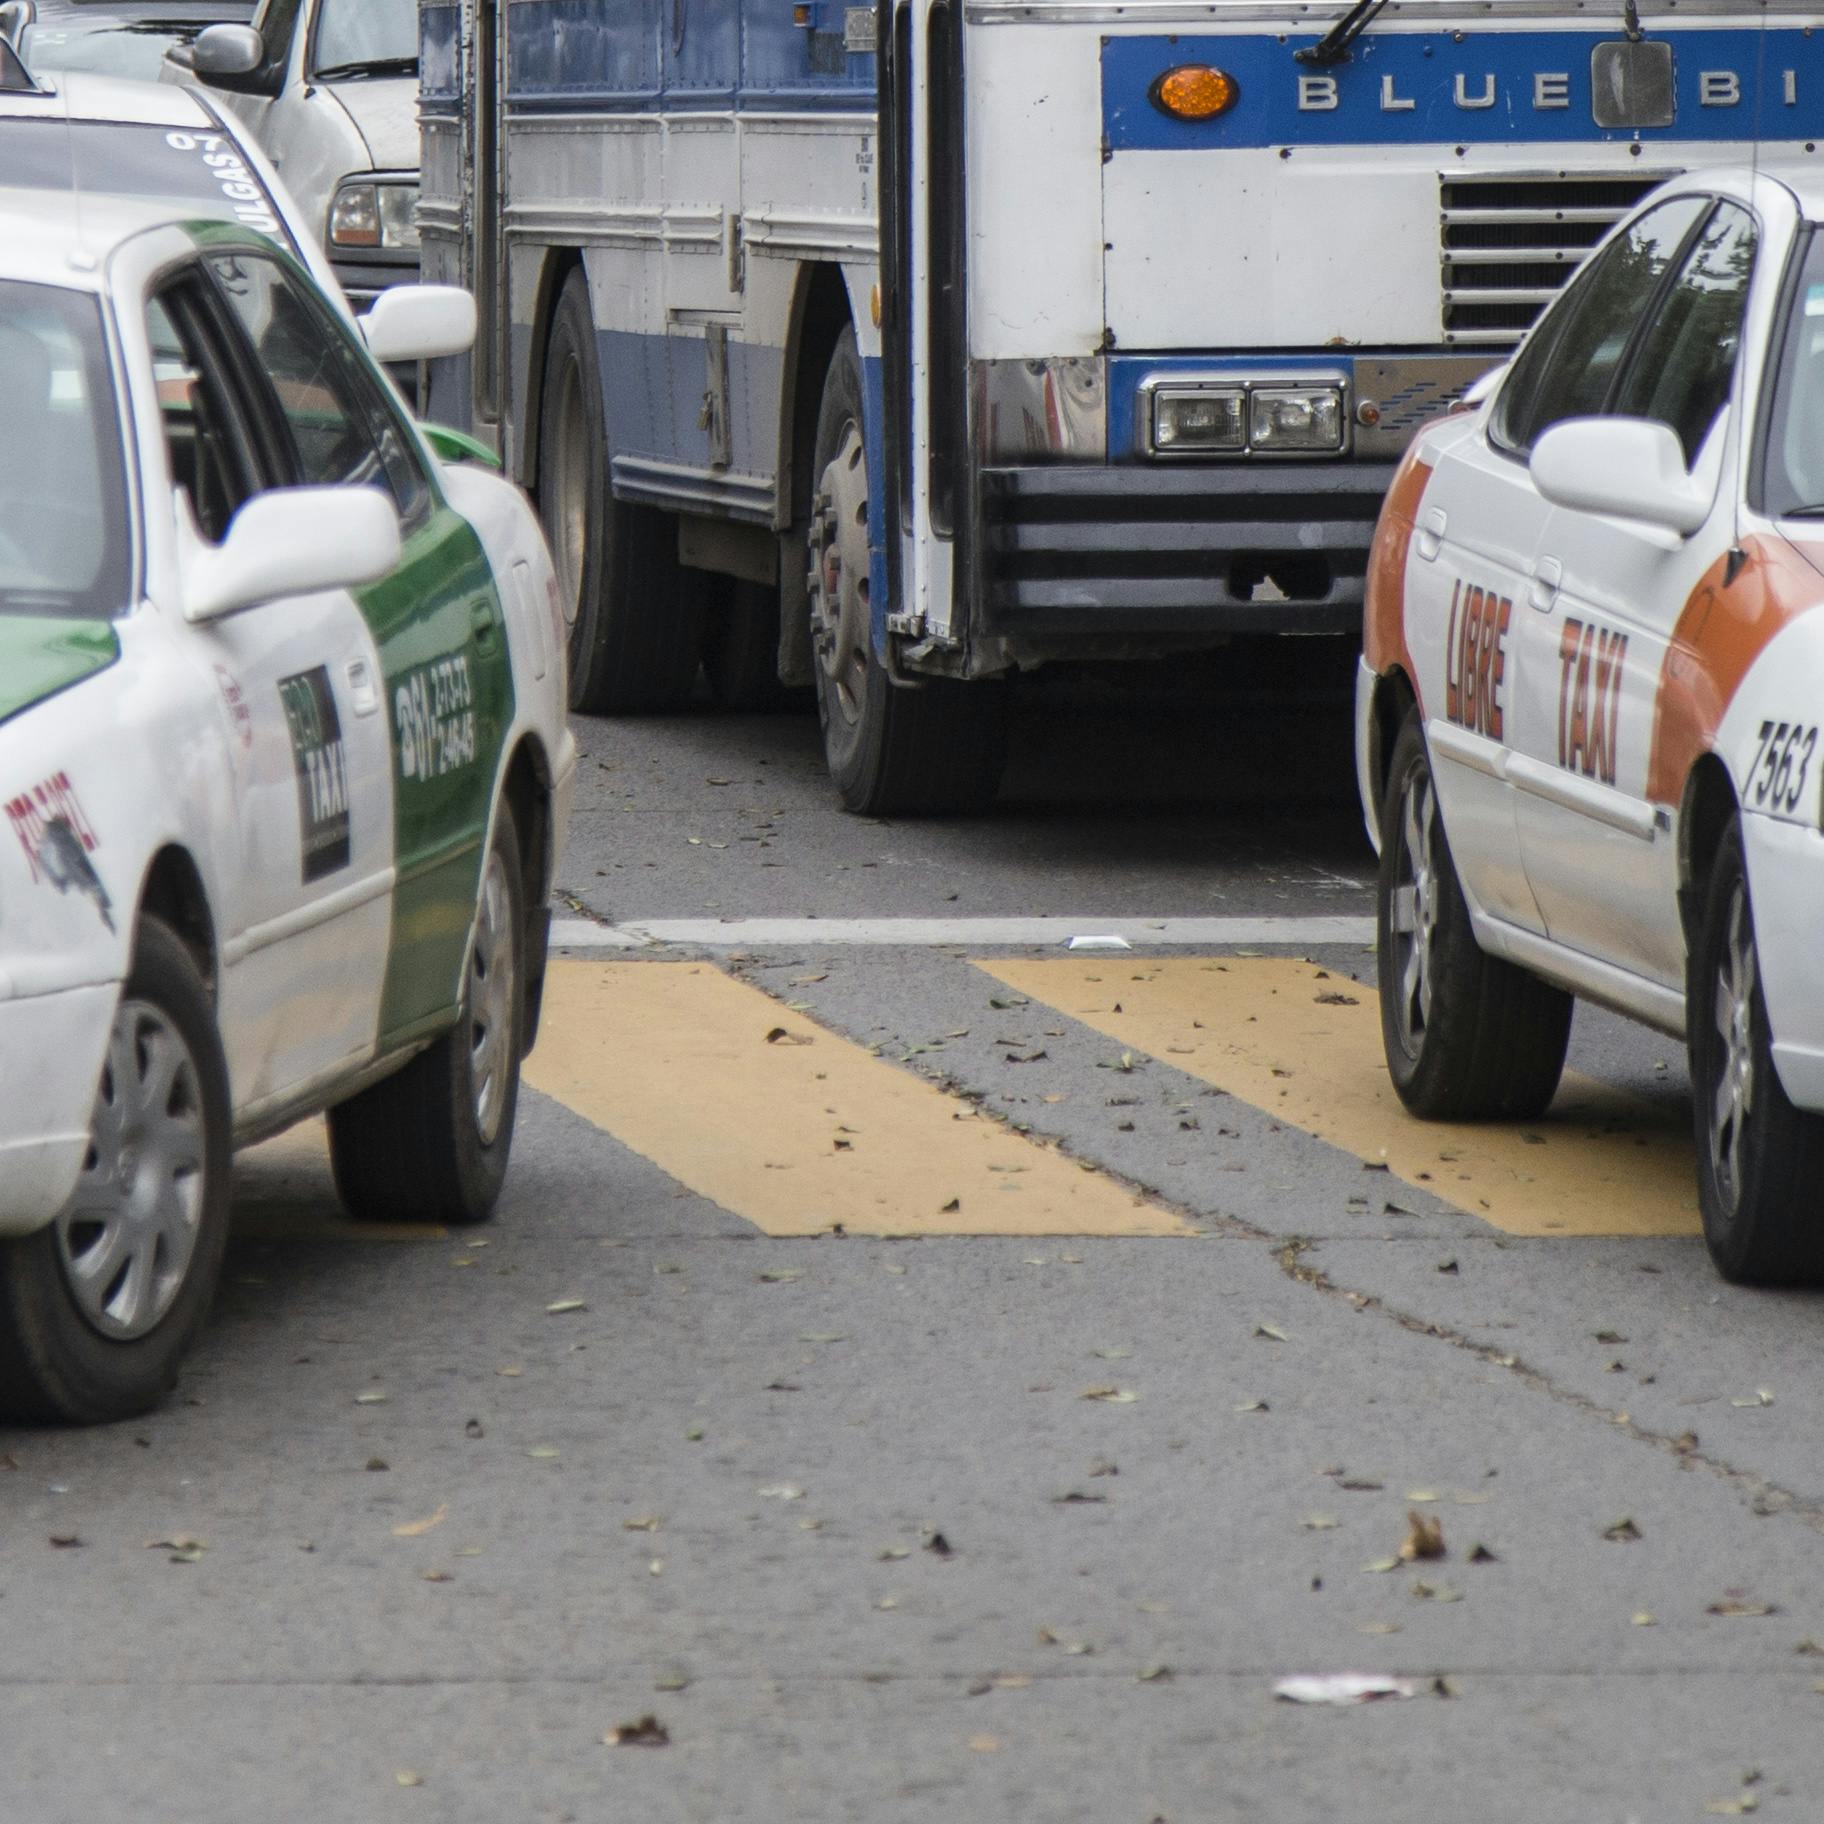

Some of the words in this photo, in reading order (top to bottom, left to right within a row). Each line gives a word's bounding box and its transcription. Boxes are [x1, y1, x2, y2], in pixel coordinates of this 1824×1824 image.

[1297, 73, 1570, 111] BLUE
[1445, 579, 1512, 742] LIBRE
[1559, 617, 1629, 786] TAXI
[1742, 720, 1818, 814] 7563
